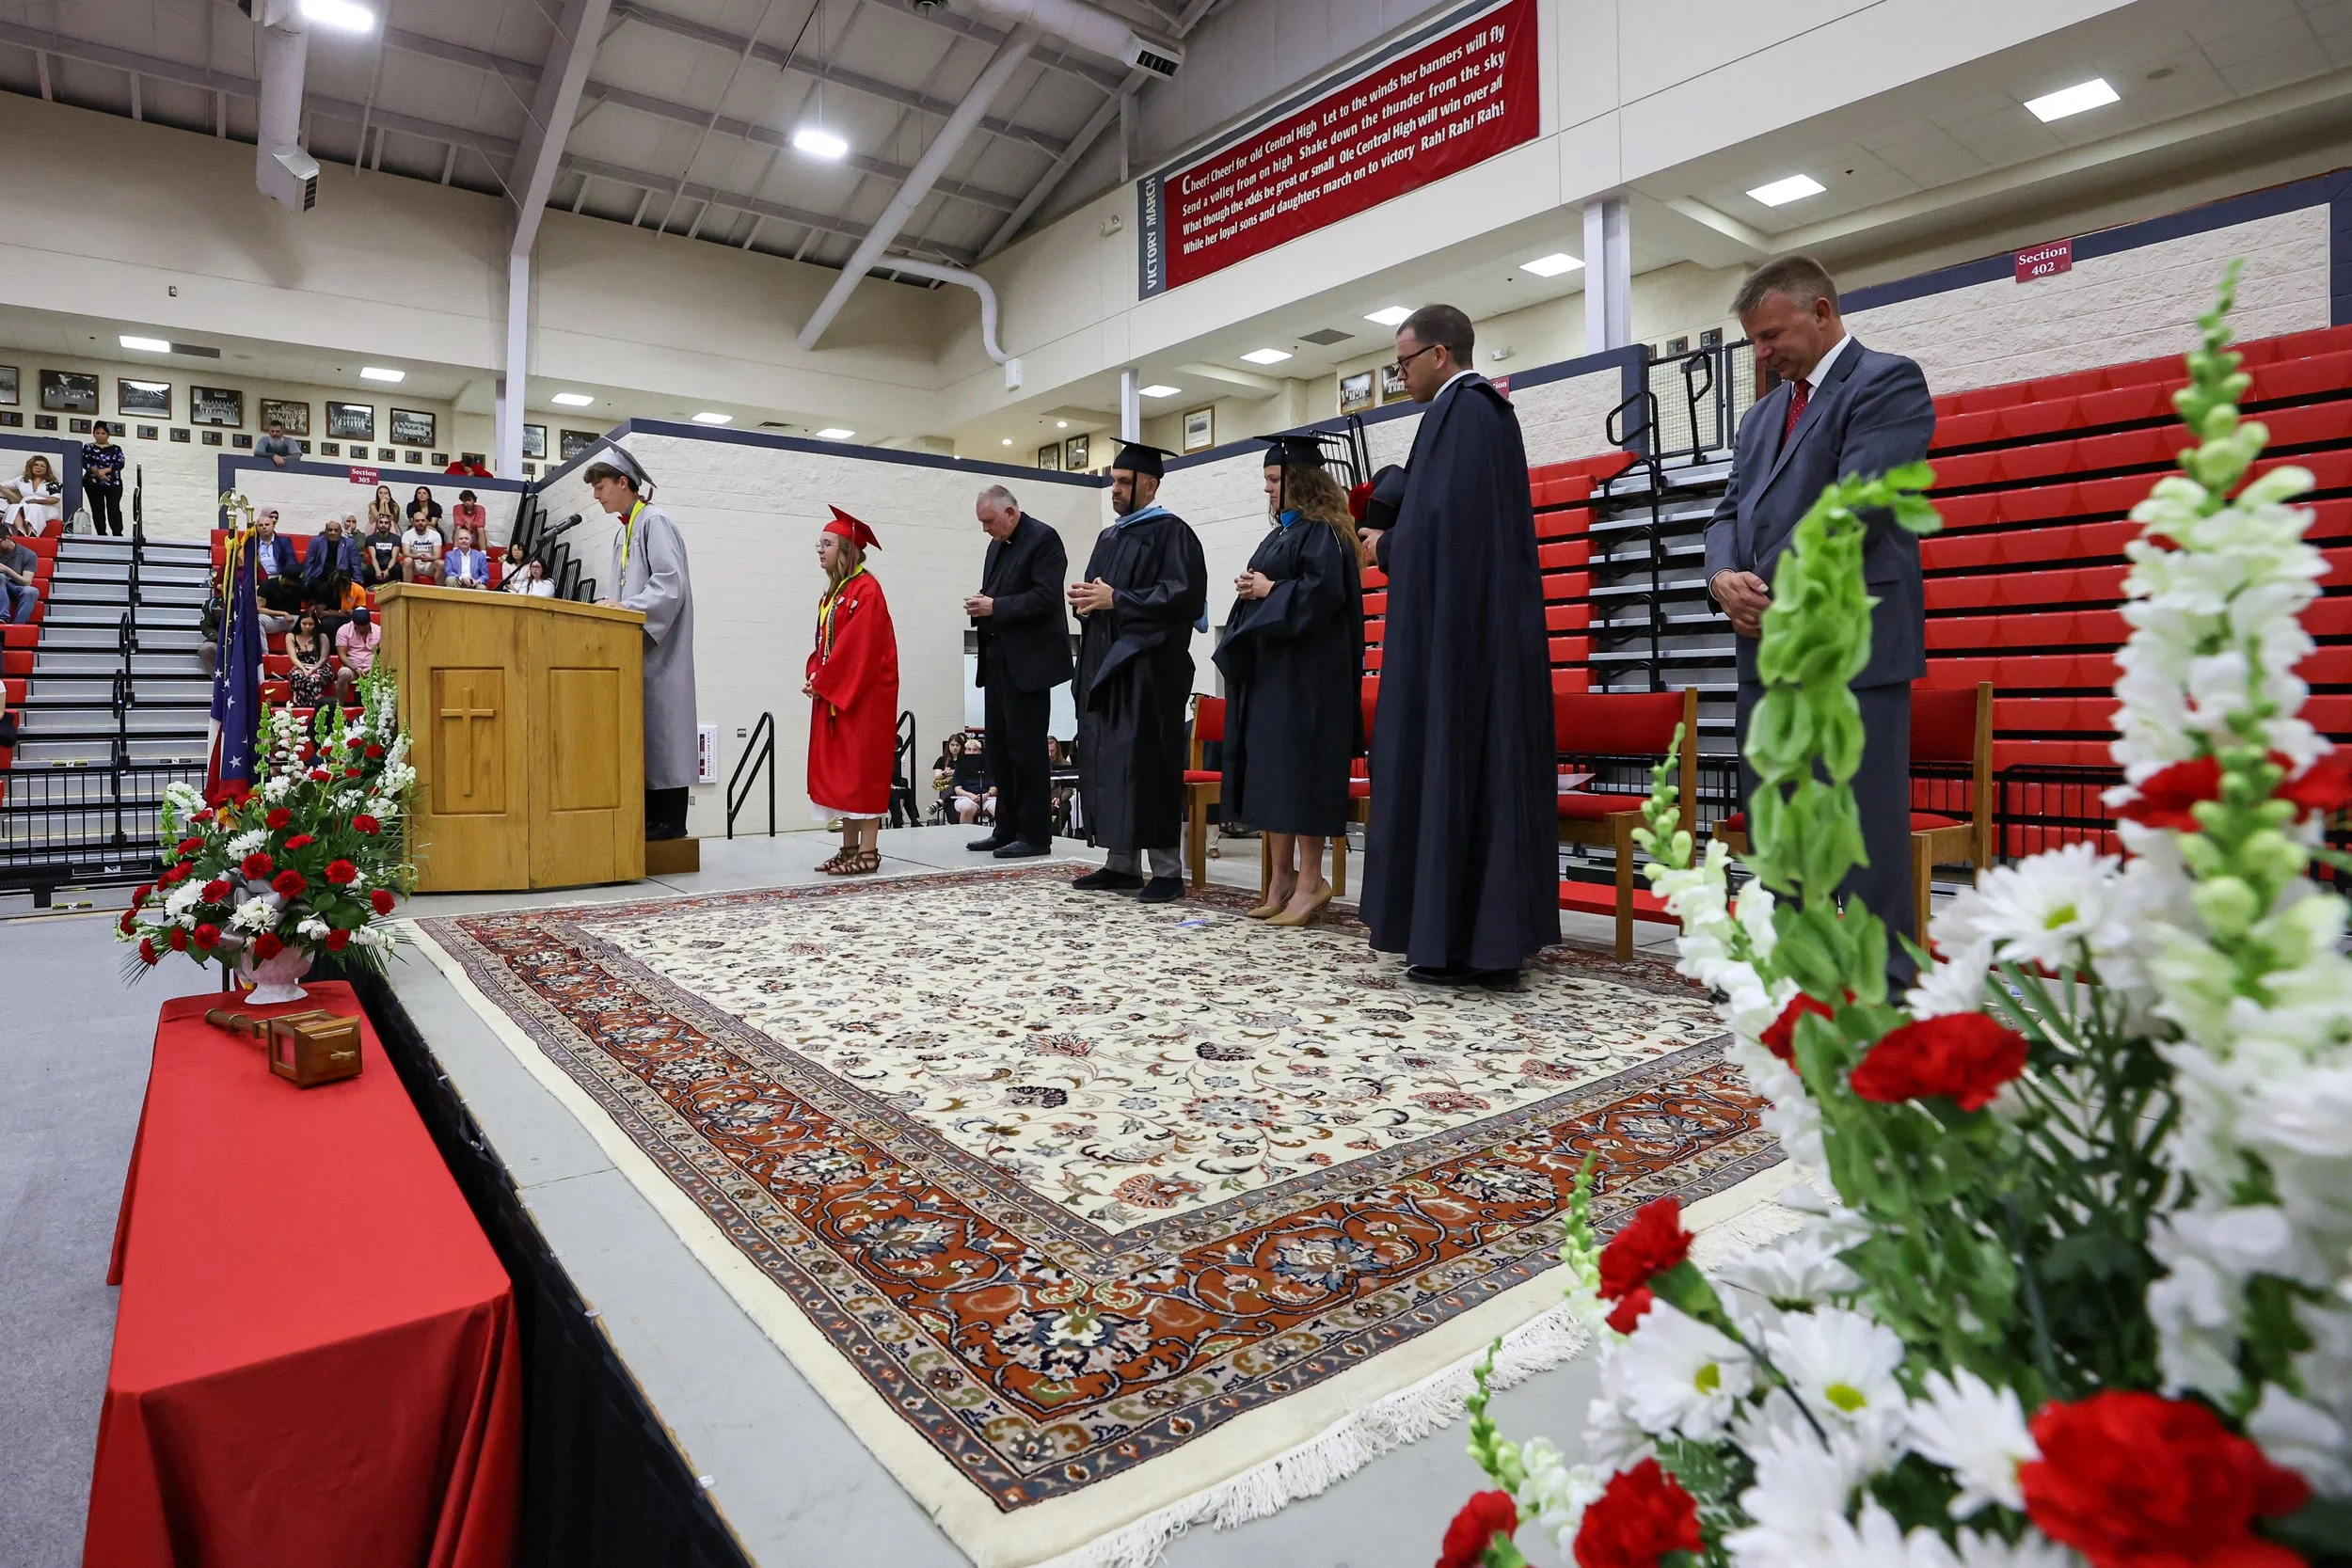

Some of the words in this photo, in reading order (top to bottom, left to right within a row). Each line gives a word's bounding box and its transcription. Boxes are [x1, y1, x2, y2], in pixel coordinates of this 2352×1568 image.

[1183, 175, 1209, 196] Cheer!
[1211, 161, 1234, 182] Cheer!
[1236, 156, 1248, 169] for
[1250, 146, 1263, 162] old
[1265, 130, 1294, 154] Central
[1296, 119, 1316, 139] High
[1324, 109, 1337, 126] Let
[1340, 105, 1349, 118] to
[1352, 96, 1367, 111] the
[1370, 78, 1398, 103] winds
[1400, 70, 1418, 87] her
[1420, 46, 1462, 78] banners
[1466, 32, 1486, 55] will
[1490, 24, 1505, 43] fly
[1183, 199, 1200, 216] Send
[1211, 184, 1234, 202] volley
[1237, 175, 1256, 191] from
[1260, 166, 1269, 180] on
[1273, 154, 1293, 173] high
[1299, 139, 1327, 160] Shake
[1330, 124, 1357, 145] down
[1361, 112, 1377, 130] the
[1382, 90, 1424, 119] thunder
[1429, 76, 1456, 98] from
[1460, 65, 1480, 82] the
[1484, 51, 1505, 71] sky
[1183, 219, 1201, 236] What
[1203, 207, 1230, 226] though
[1232, 200, 1244, 214] the
[1245, 191, 1263, 208] odds
[1264, 186, 1274, 198] be
[1277, 174, 1297, 196] great
[1299, 169, 1309, 182] or
[1311, 155, 1334, 178] small
[1340, 148, 1354, 164] Ole
[1357, 130, 1391, 155] Central
[1393, 119, 1416, 139] High
[1418, 107, 1438, 127] will
[1440, 98, 1460, 117] win
[1464, 86, 1488, 106] over
[1490, 73, 1502, 94] all
[1184, 238, 1203, 255] While
[1205, 233, 1217, 245] her
[1219, 223, 1237, 240] loyal
[1240, 216, 1257, 230] sons
[1259, 205, 1275, 221] and
[1278, 187, 1320, 214] daughters
[1323, 172, 1351, 194] march
[1354, 167, 1365, 181] on
[1368, 161, 1378, 174] to
[1381, 145, 1415, 168] victory
[1422, 130, 1445, 151] Rah!
[1449, 116, 1474, 139] Rah!
[1478, 101, 1504, 125] Rah!
[1146, 177, 1156, 226] MARCH
[1148, 231, 1157, 290] VICTORY
[2019, 246, 2067, 265] Section
[2031, 262, 2055, 275] 402
[352, 468, 376, 477] Section
